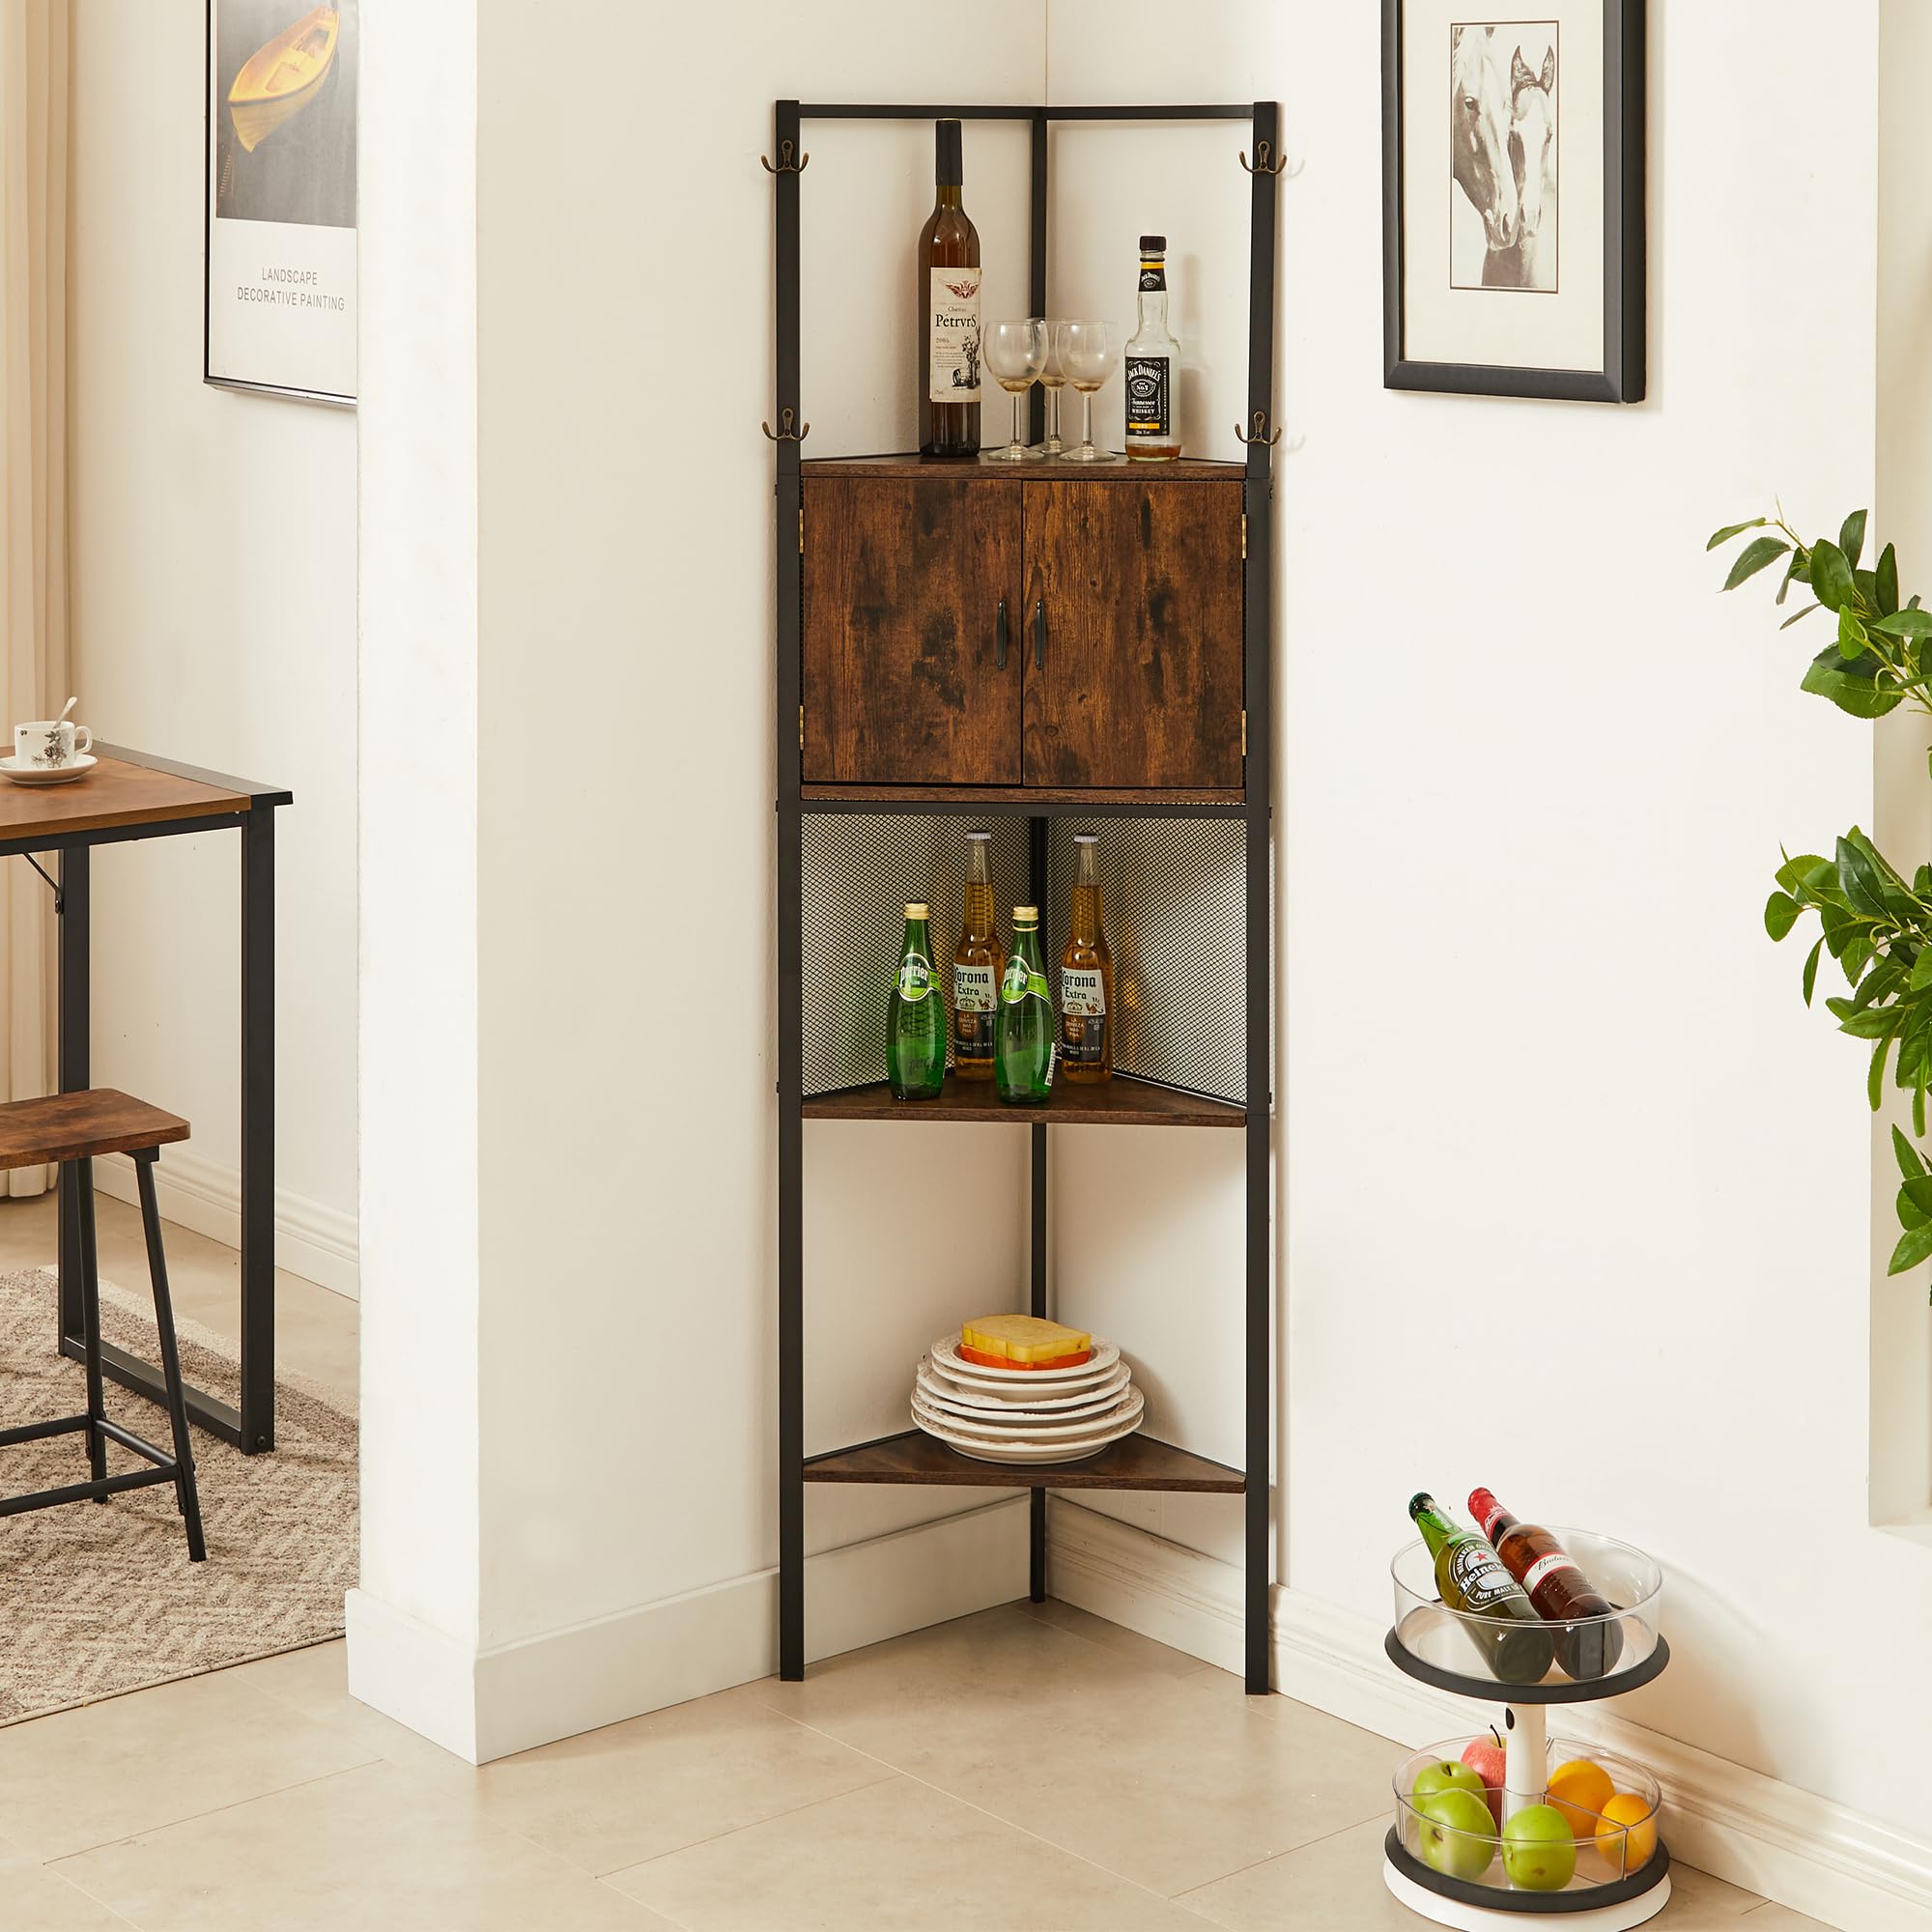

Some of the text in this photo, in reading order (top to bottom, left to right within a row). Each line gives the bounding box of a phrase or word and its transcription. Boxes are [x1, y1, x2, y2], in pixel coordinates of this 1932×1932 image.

[262, 267, 318, 286] LANDSCAPE
[237, 286, 345, 312] DECORATIVE PAINTING
[957, 983, 980, 996] Extra
[1065, 986, 1087, 1000] Extra
[1475, 1590, 1492, 1600] PURE
[1493, 1586, 1511, 1596] MALT
